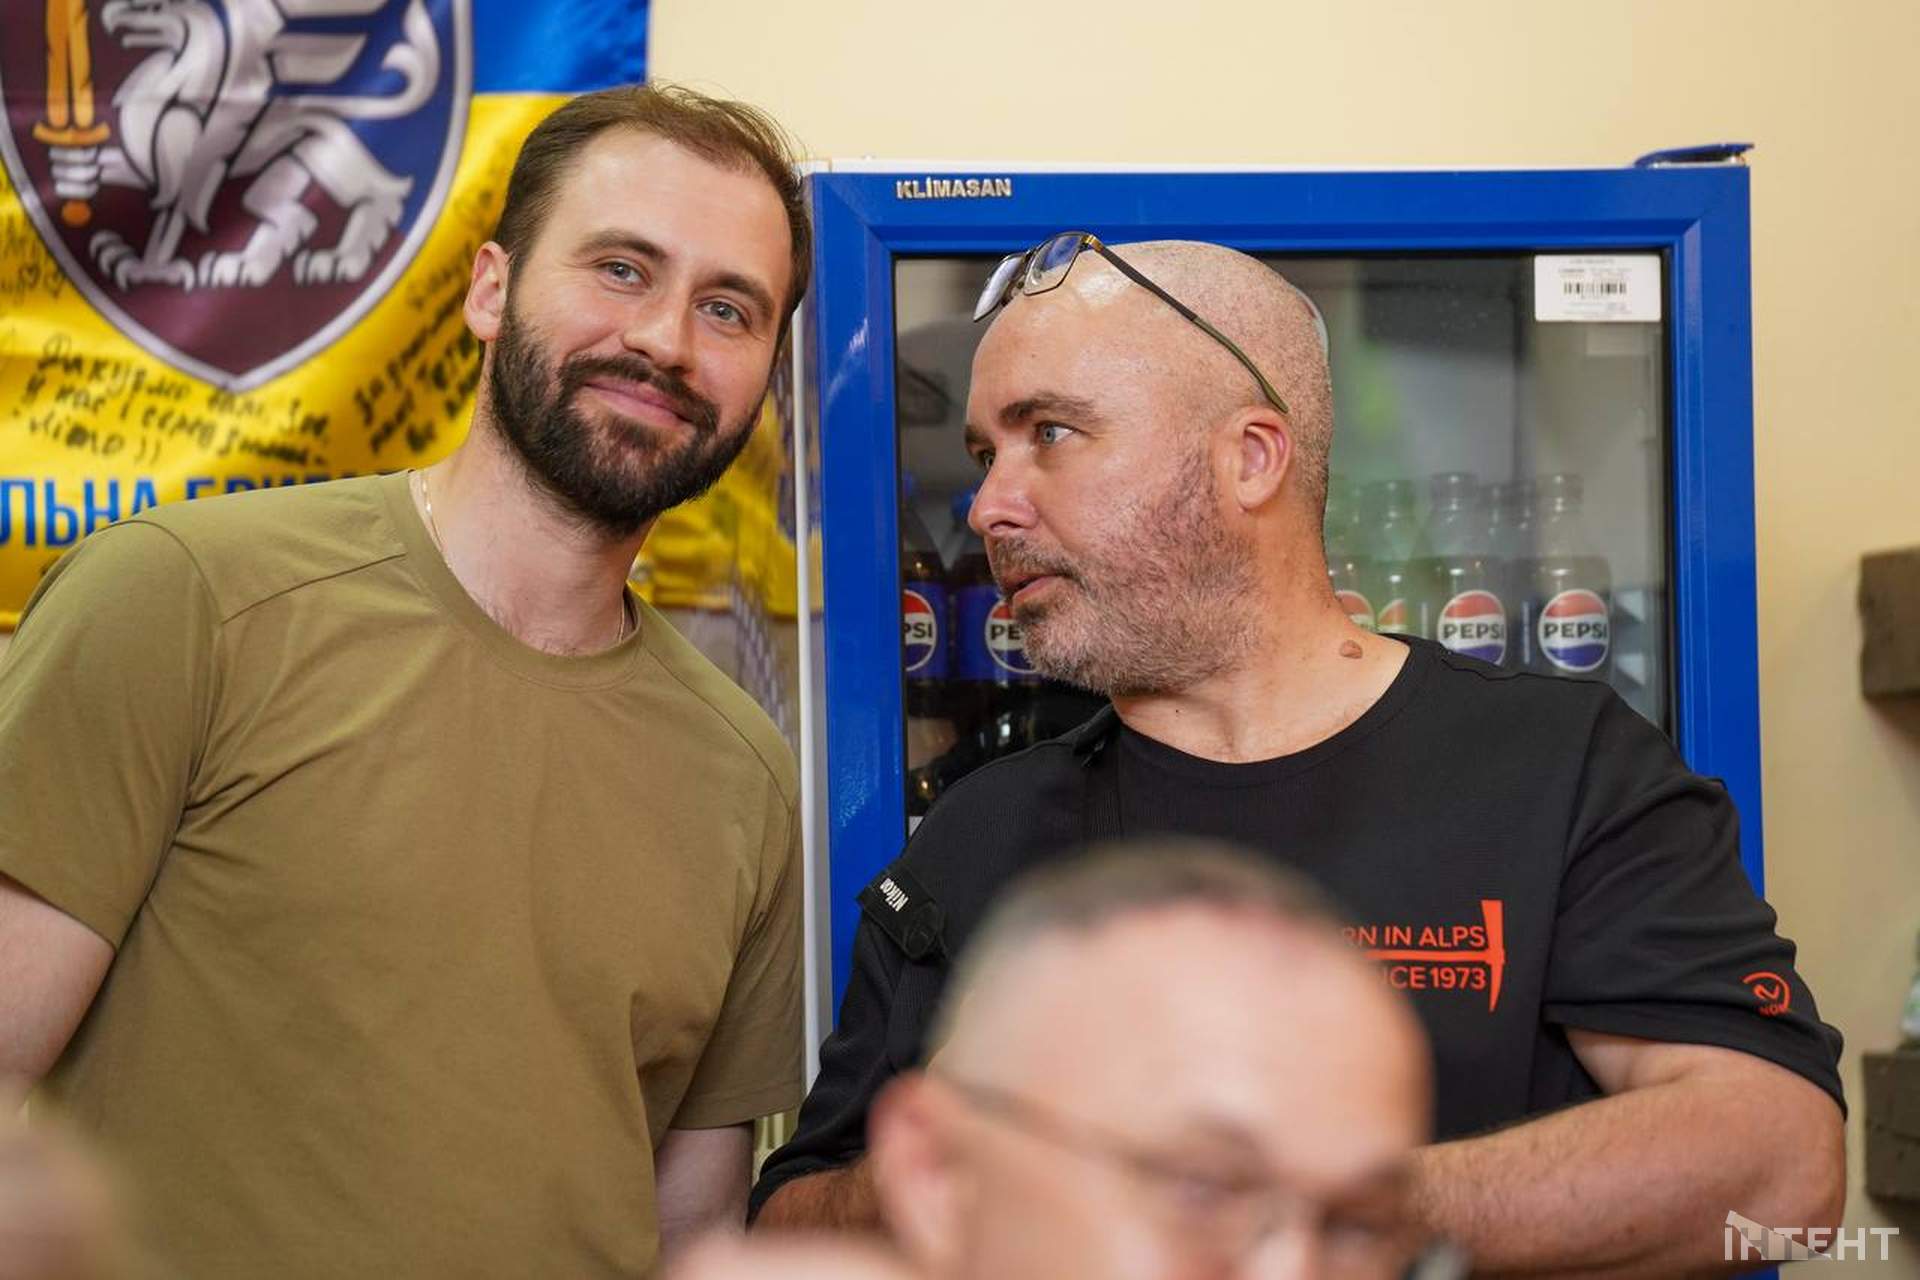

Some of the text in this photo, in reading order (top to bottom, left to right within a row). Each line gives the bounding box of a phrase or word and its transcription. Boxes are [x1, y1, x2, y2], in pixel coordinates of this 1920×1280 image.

[0, 478, 158, 547] ЛЬНА
[903, 622, 932, 639] PSI
[991, 623, 1021, 641] PE
[1543, 622, 1607, 640] PEPSI
[1343, 926, 1486, 948] RN IN ALPS
[1385, 966, 1487, 990] CE 1973
